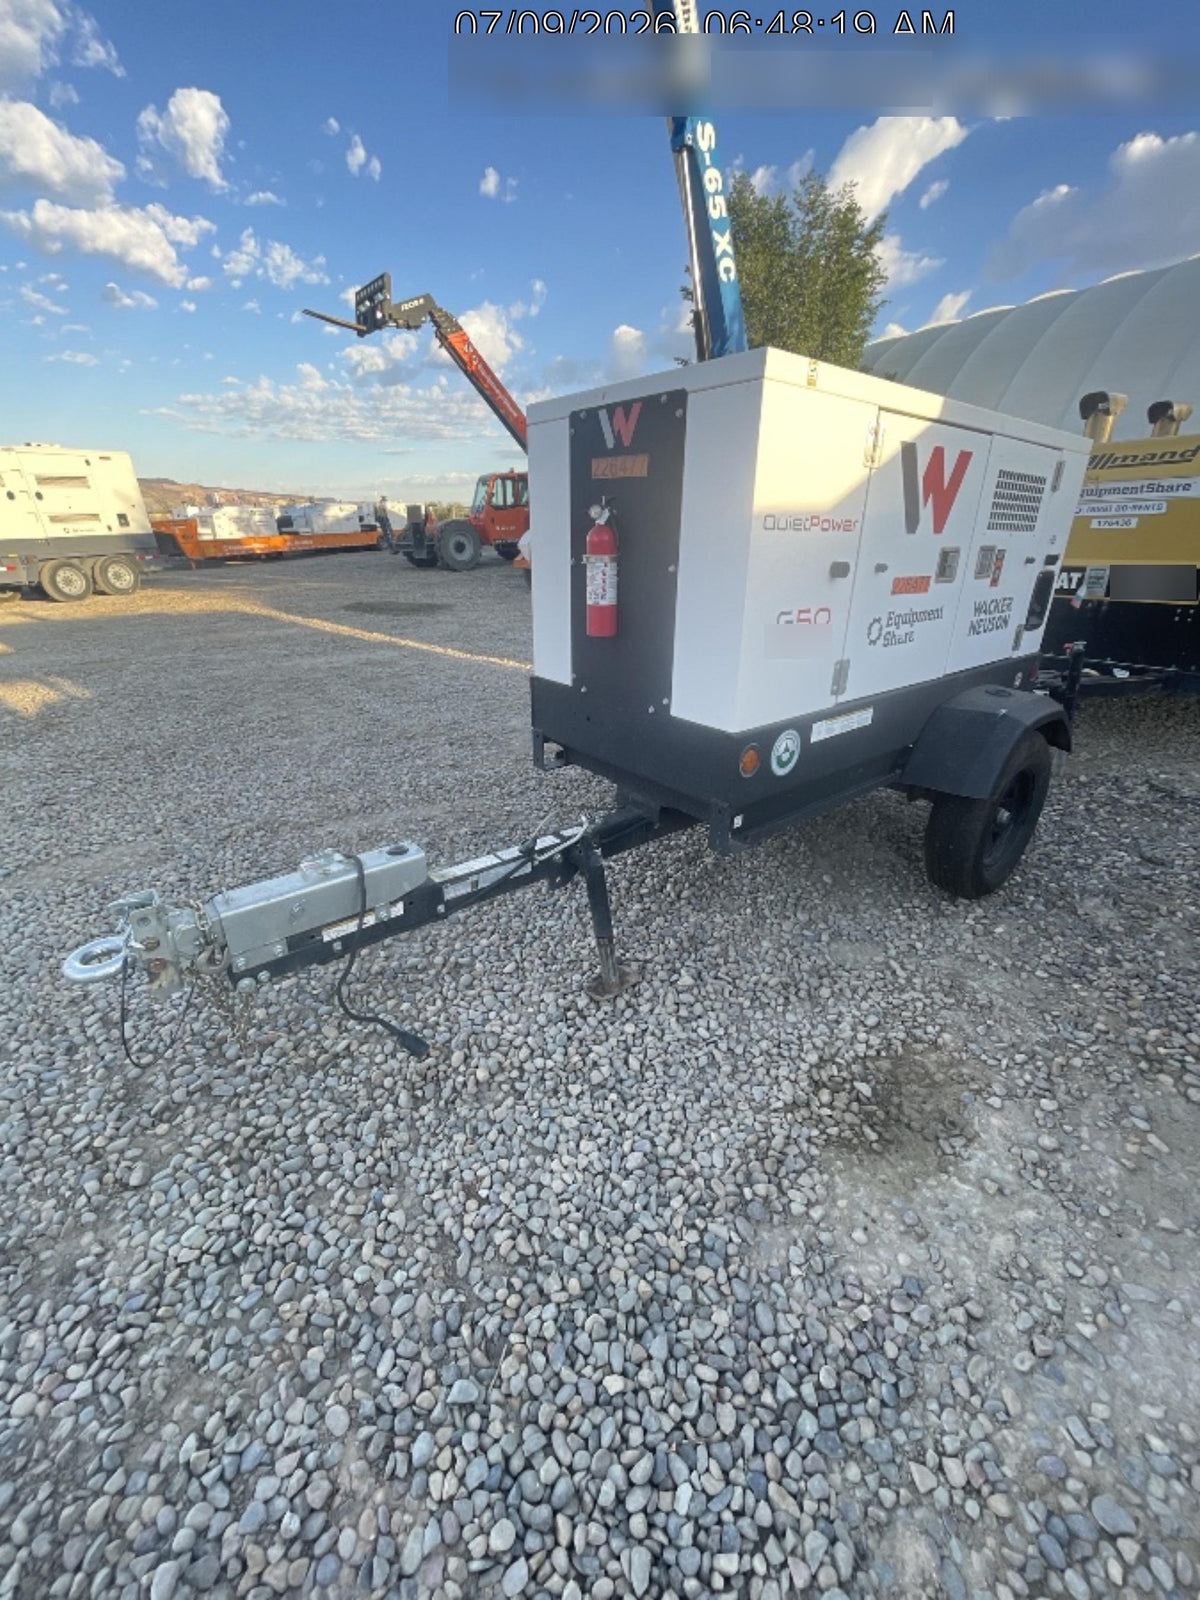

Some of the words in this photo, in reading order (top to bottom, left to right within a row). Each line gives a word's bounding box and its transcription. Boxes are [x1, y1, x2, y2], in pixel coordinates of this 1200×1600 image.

[696, 119, 727, 220] S-65
[711, 228, 737, 283] XC
[1087, 445, 1200, 470] llmand
[1080, 481, 1192, 498] quipmentShare
